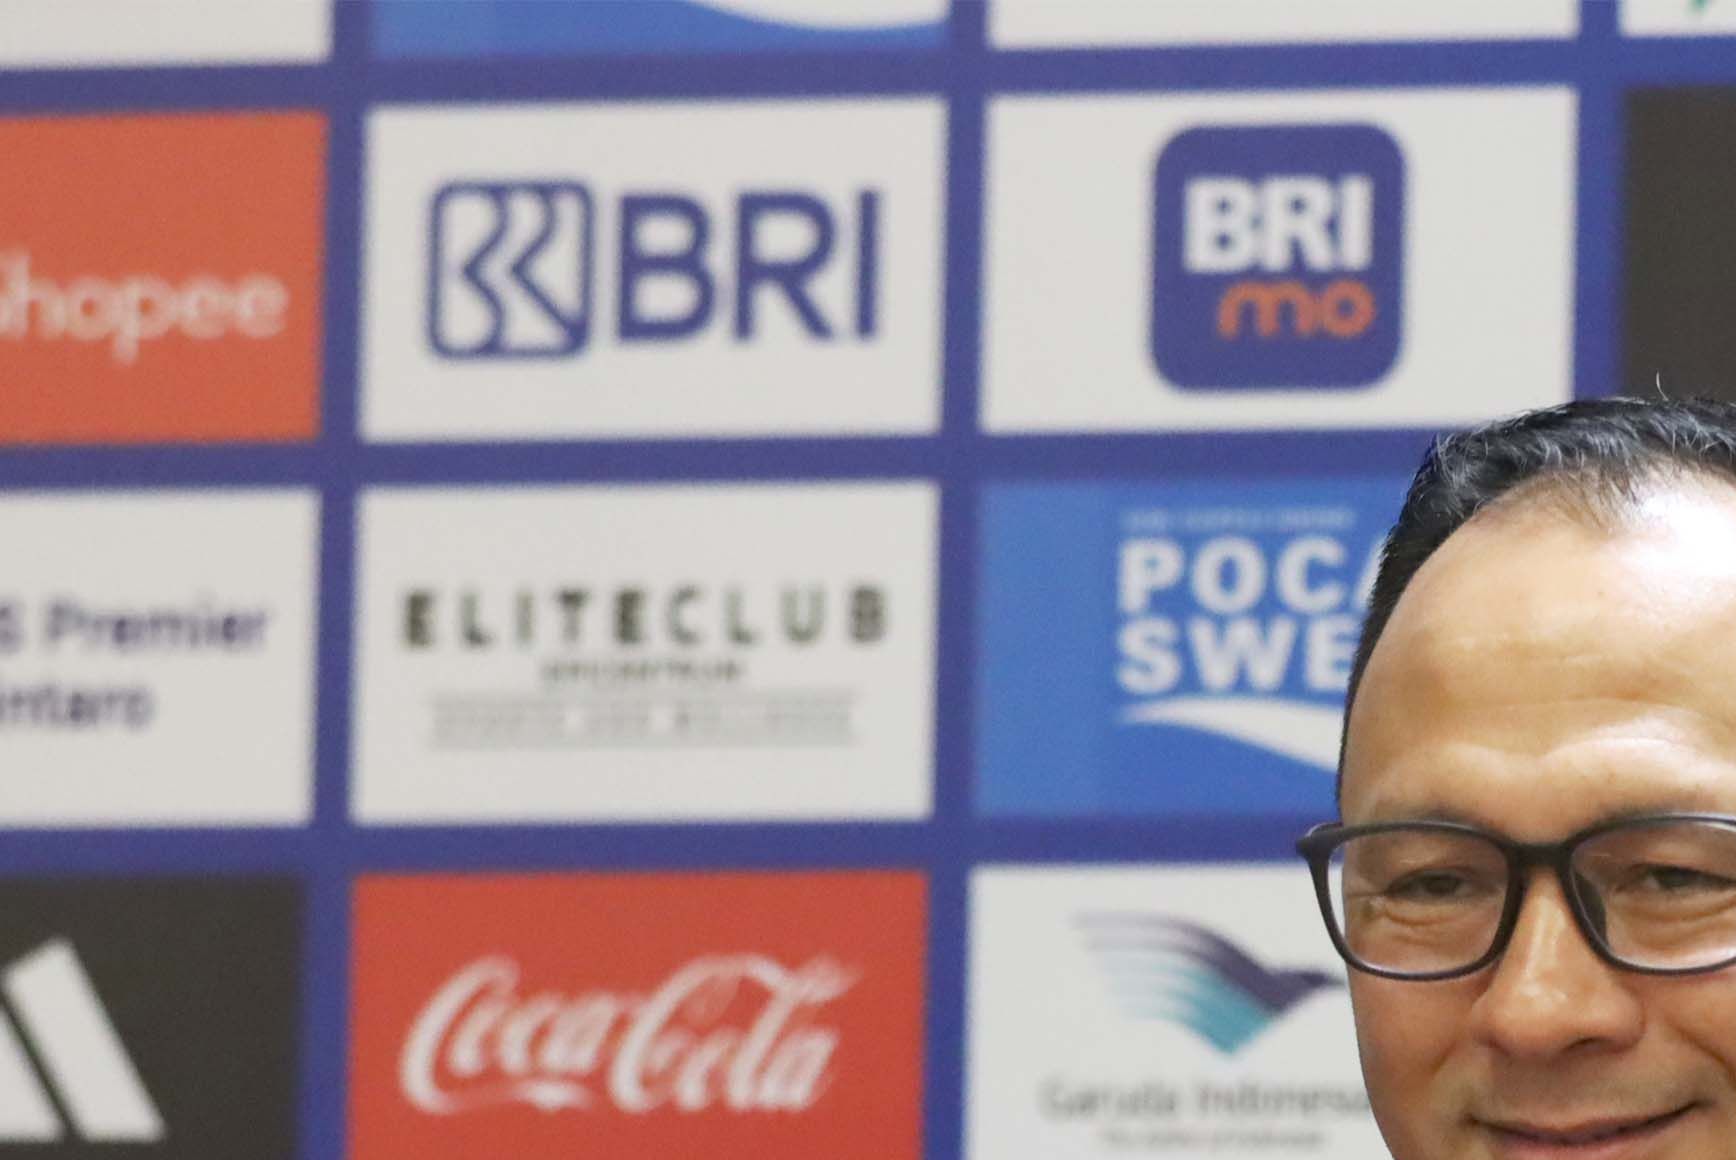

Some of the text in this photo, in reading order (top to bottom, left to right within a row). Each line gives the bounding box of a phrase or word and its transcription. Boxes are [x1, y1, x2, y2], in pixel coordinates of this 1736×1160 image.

[1185, 174, 1374, 274] BRI
[616, 188, 880, 345] BRI
[1217, 280, 1377, 340] mo
[402, 584, 887, 647] ELITECLUB
